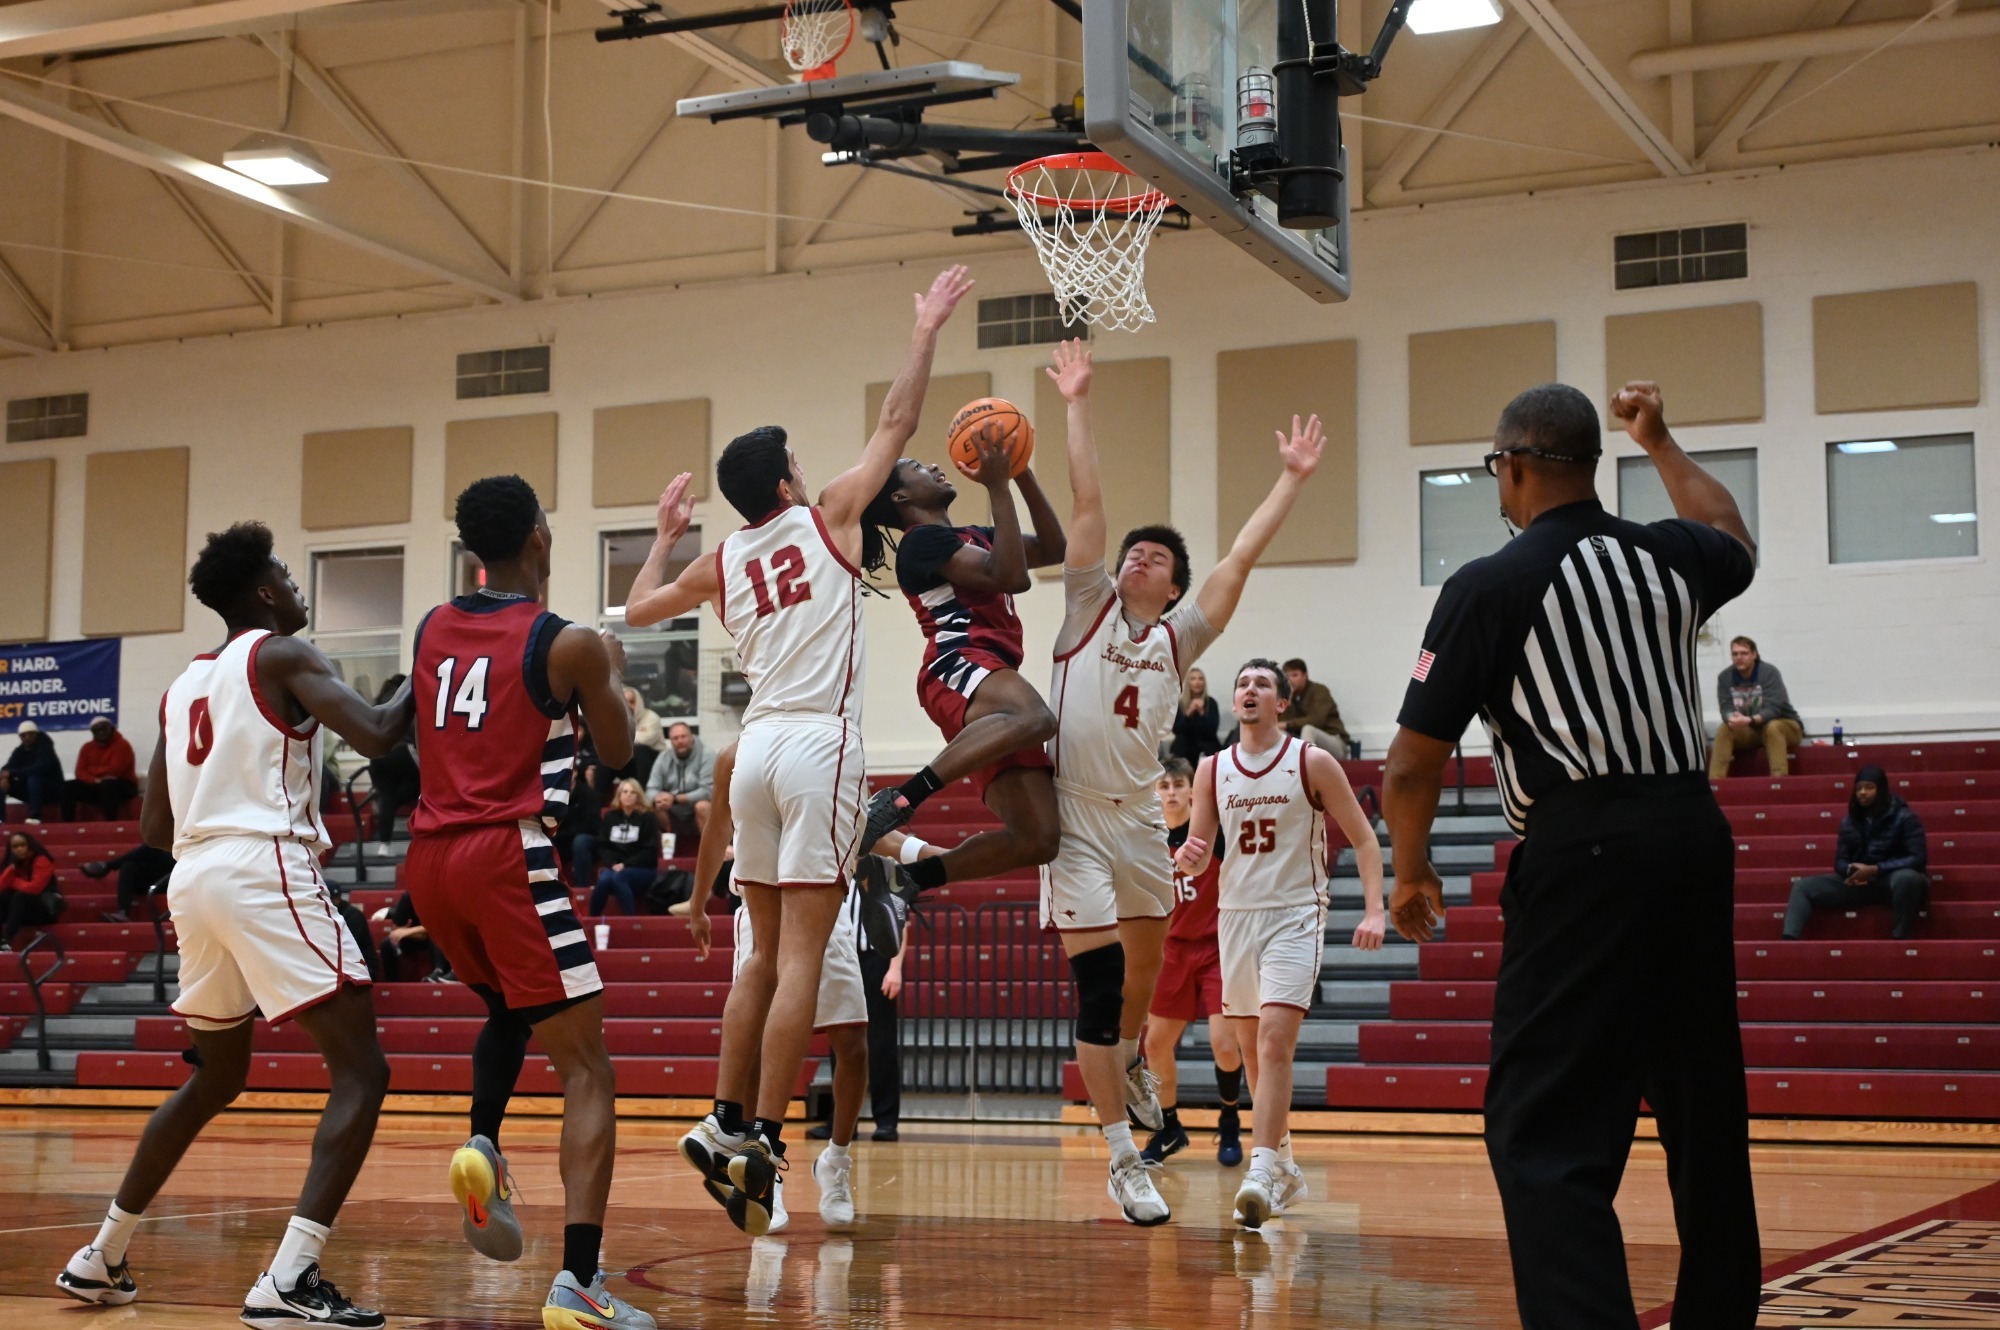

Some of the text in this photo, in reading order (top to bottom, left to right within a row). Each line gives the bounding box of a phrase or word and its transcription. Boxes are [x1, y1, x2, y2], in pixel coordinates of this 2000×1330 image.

[948, 404, 994, 438] Wilson
[744, 544, 812, 618] 12
[12, 657, 59, 673] HARD.
[1101, 643, 1165, 673] Kangaroos
[0, 679, 66, 695] HARDER.
[435, 656, 490, 731] 14
[27, 698, 115, 717] EVERYONE.
[1114, 685, 1139, 729] 4
[187, 696, 213, 766] 0
[1225, 794, 1290, 812] Kangaroos
[1238, 818, 1276, 854] 25
[1174, 875, 1197, 903] 15
